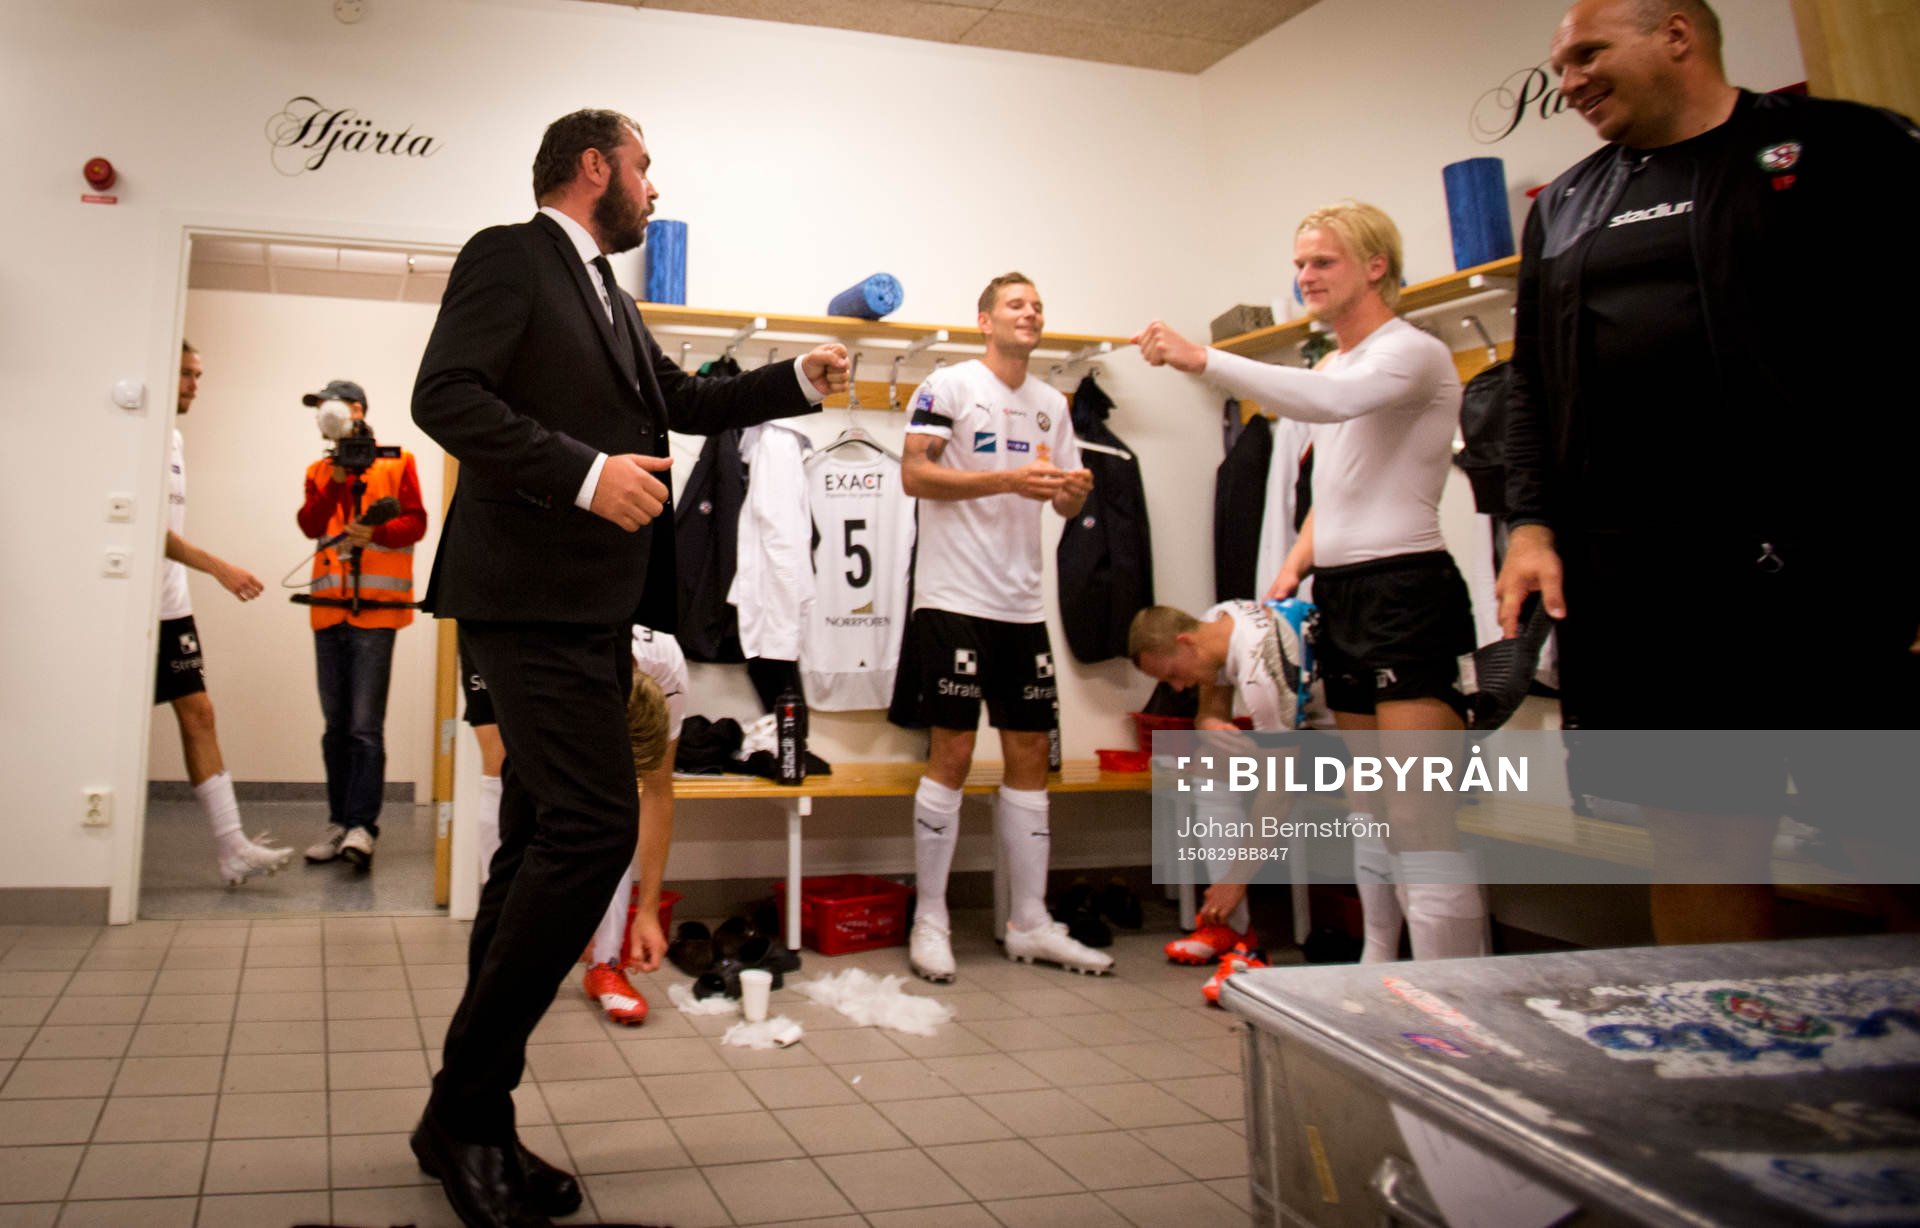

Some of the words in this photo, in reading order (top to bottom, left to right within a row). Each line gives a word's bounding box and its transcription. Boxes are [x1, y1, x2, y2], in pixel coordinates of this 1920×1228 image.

[265, 96, 446, 177] Hjärta
[825, 473, 884, 491] EXACT
[844, 519, 872, 589] 5
